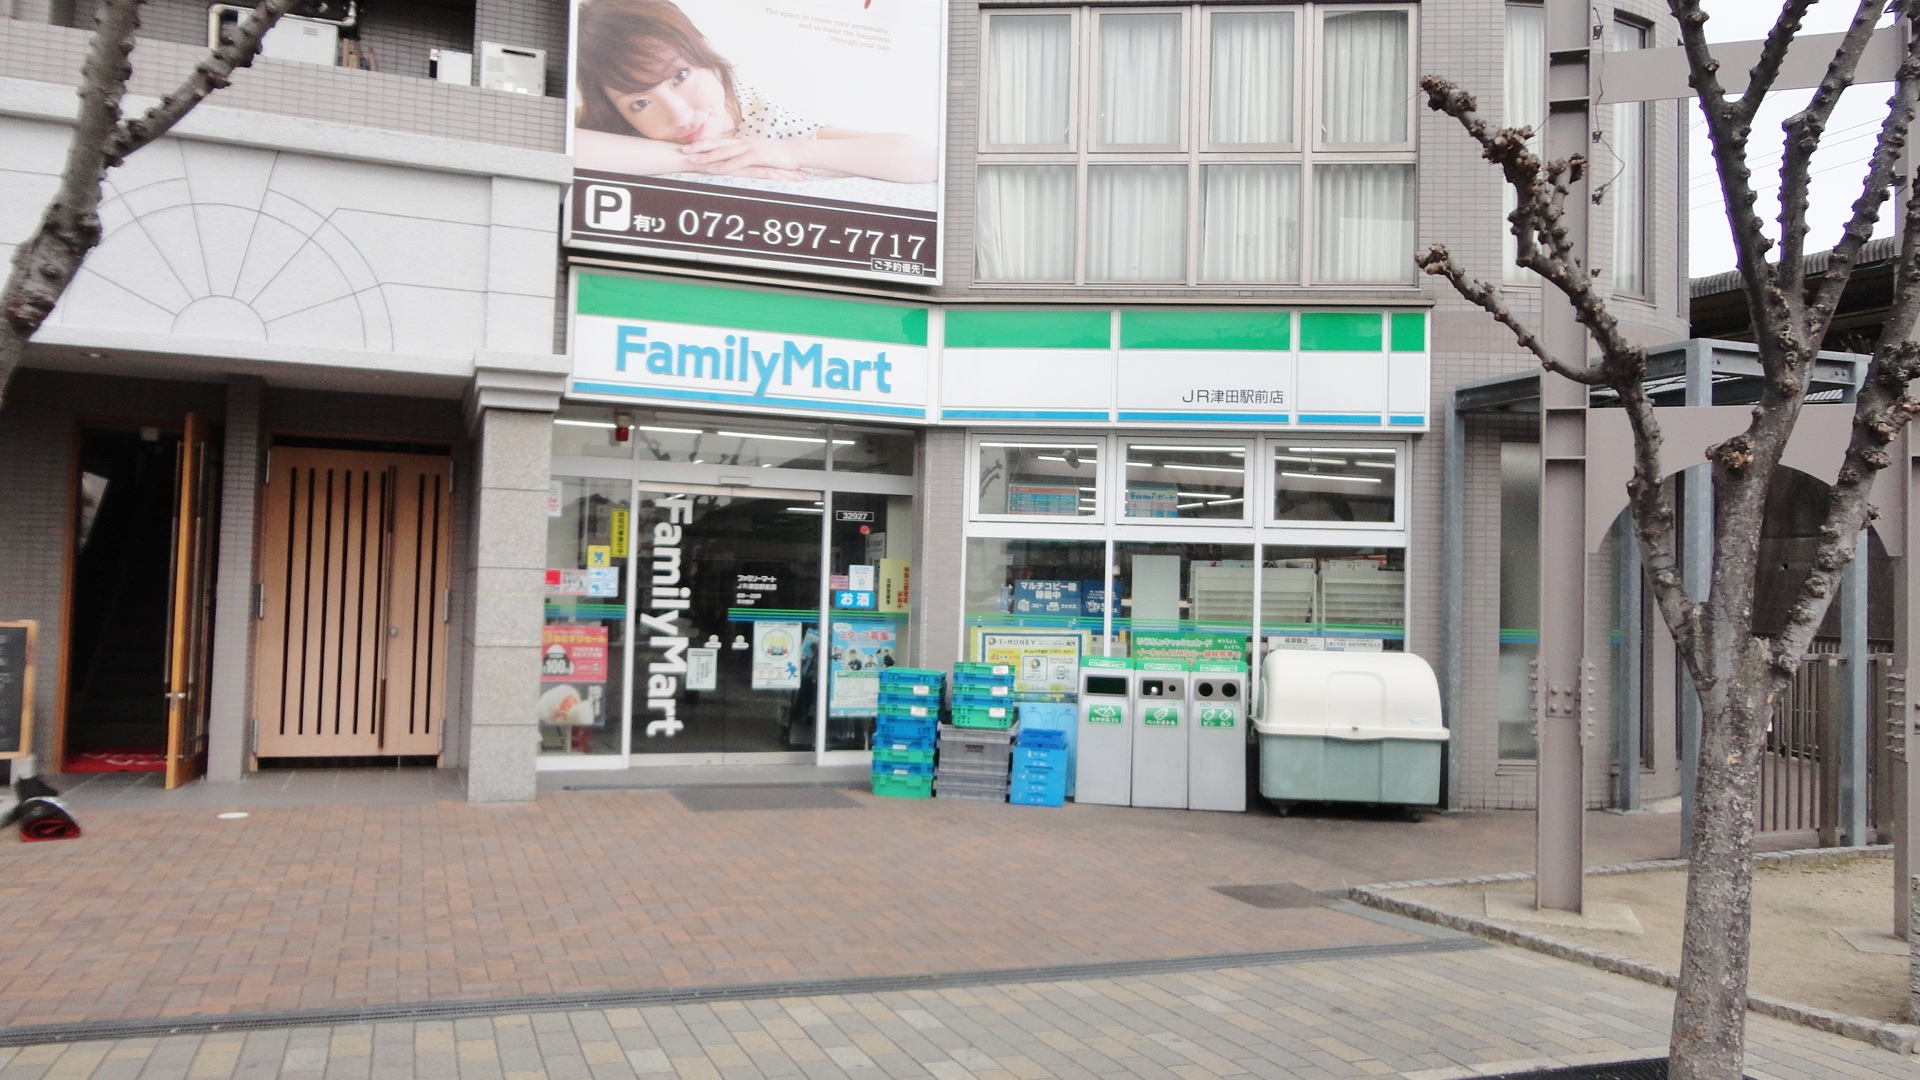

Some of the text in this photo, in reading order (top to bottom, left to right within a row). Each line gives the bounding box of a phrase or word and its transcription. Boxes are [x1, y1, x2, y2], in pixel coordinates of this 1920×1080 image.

[765, 7, 778, 15] The
[780, 11, 800, 19] space
[811, 16, 832, 25] create
[834, 20, 850, 28] your
[823, 27, 841, 35] make
[856, 31, 891, 43] happiness
[830, 36, 891, 52] through your hair
[678, 209, 926, 260] 072-897-7717
[874, 259, 922, 275] ご予約優先
[615, 324, 892, 396] FamilyMart
[1182, 389, 1284, 404] JR津田駅前店
[842, 512, 868, 520] 32927
[840, 592, 870, 607] お酒
[640, 498, 694, 737] FamilyMart
[839, 631, 889, 641] スタッフ募集
[998, 638, 1036, 646] T-MONEY
